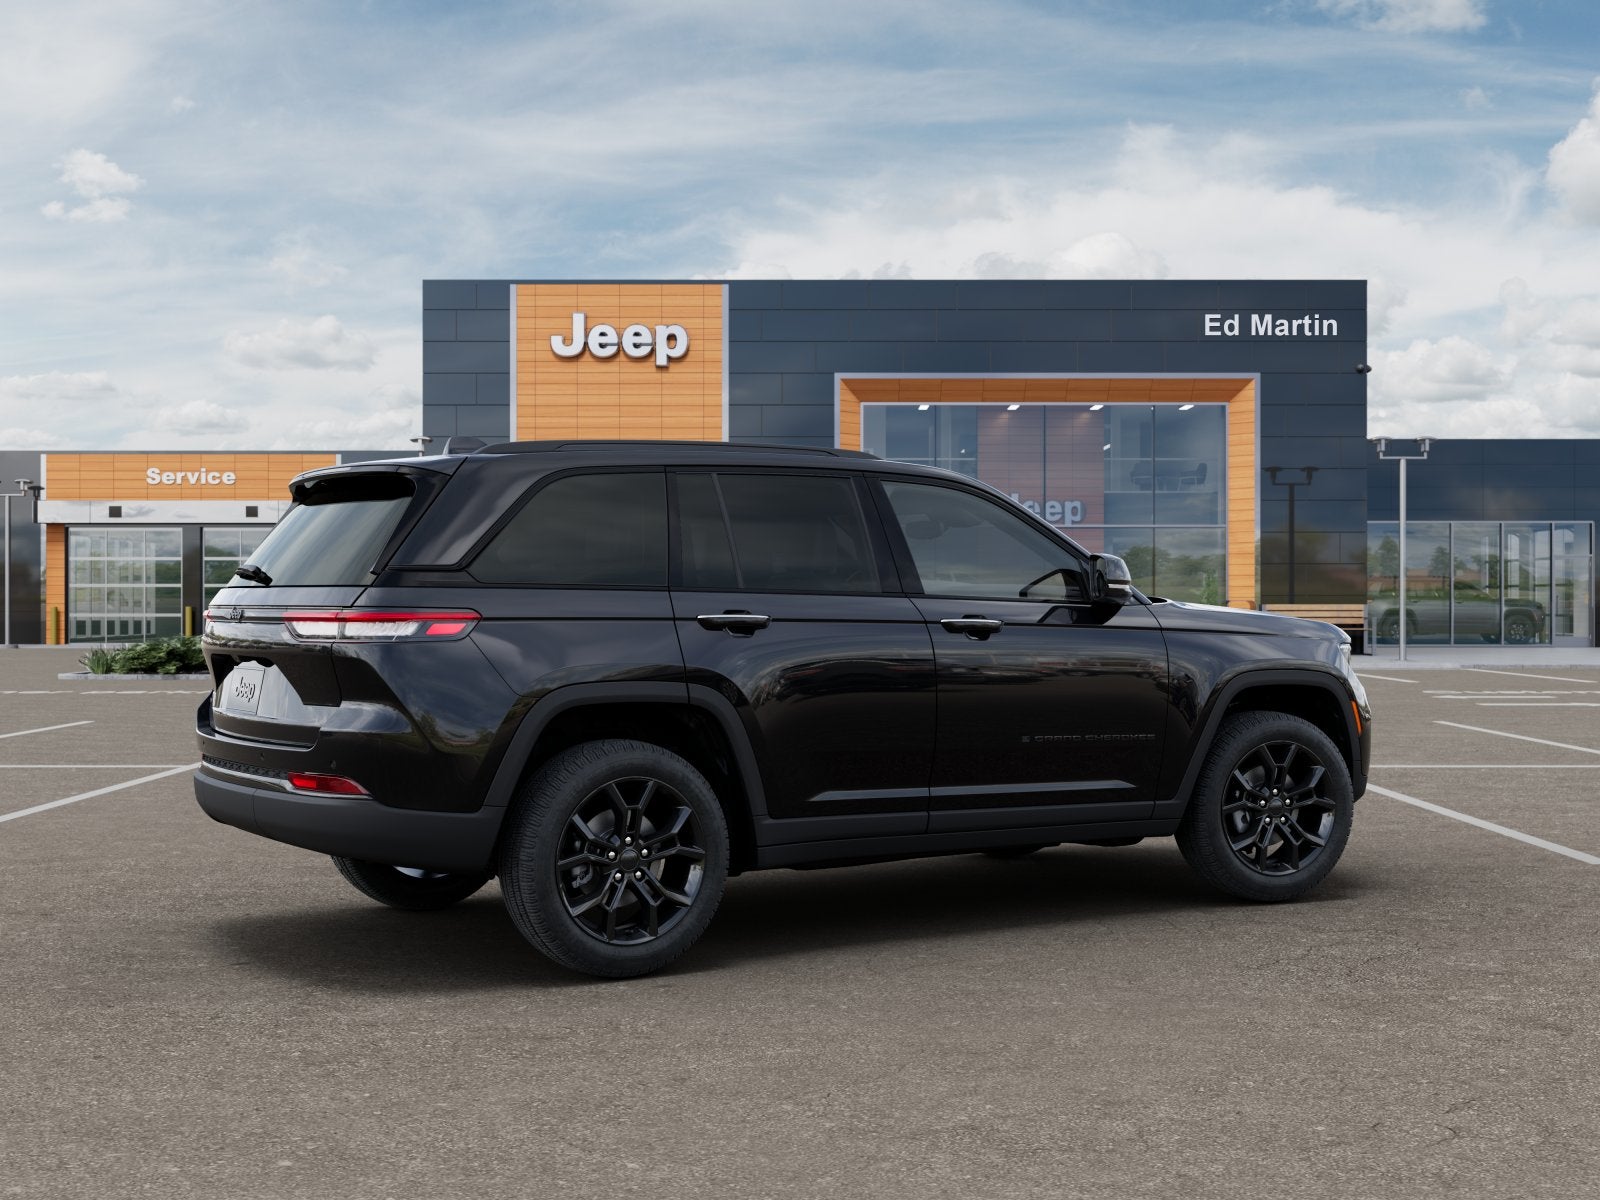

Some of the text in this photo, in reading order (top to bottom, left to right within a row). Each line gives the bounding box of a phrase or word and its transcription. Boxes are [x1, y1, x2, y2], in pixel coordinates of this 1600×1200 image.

[1204, 313, 1339, 337] Ed Martin
[550, 312, 689, 368] Jeep
[146, 467, 237, 486] Service
[1010, 493, 1084, 527] eep
